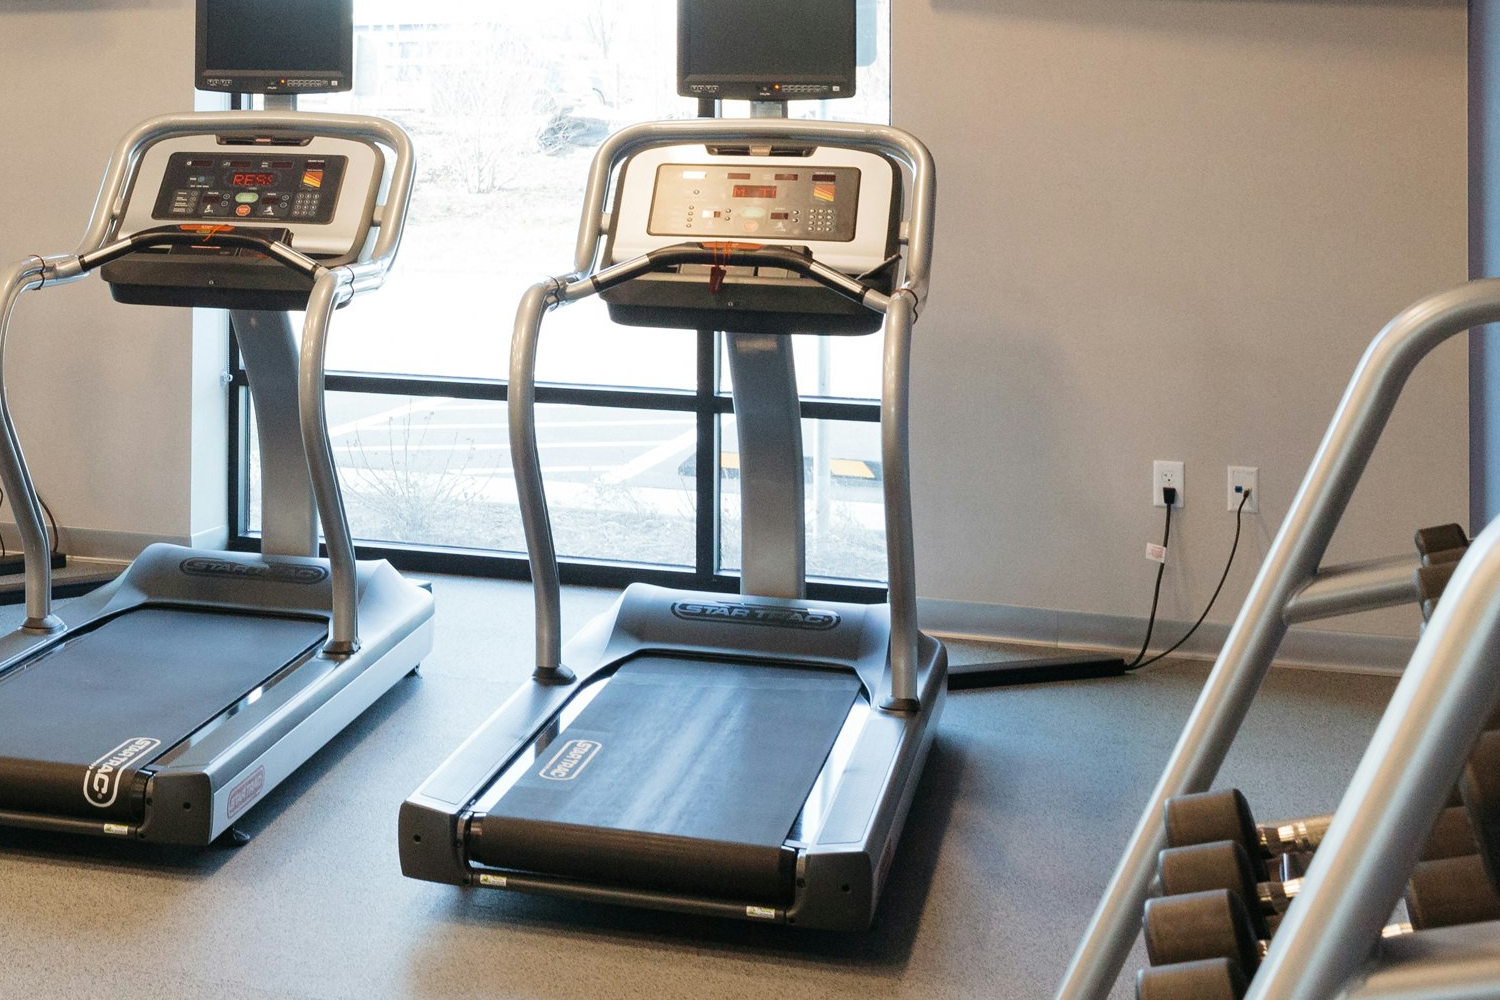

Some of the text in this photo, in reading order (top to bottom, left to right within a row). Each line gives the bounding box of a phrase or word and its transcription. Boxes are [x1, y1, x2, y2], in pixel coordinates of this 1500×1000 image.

[191, 561, 247, 575] STAR
[684, 605, 750, 617] STAR
[93, 739, 152, 794] STAR TRAC
[550, 741, 593, 777] STAR TRAC
